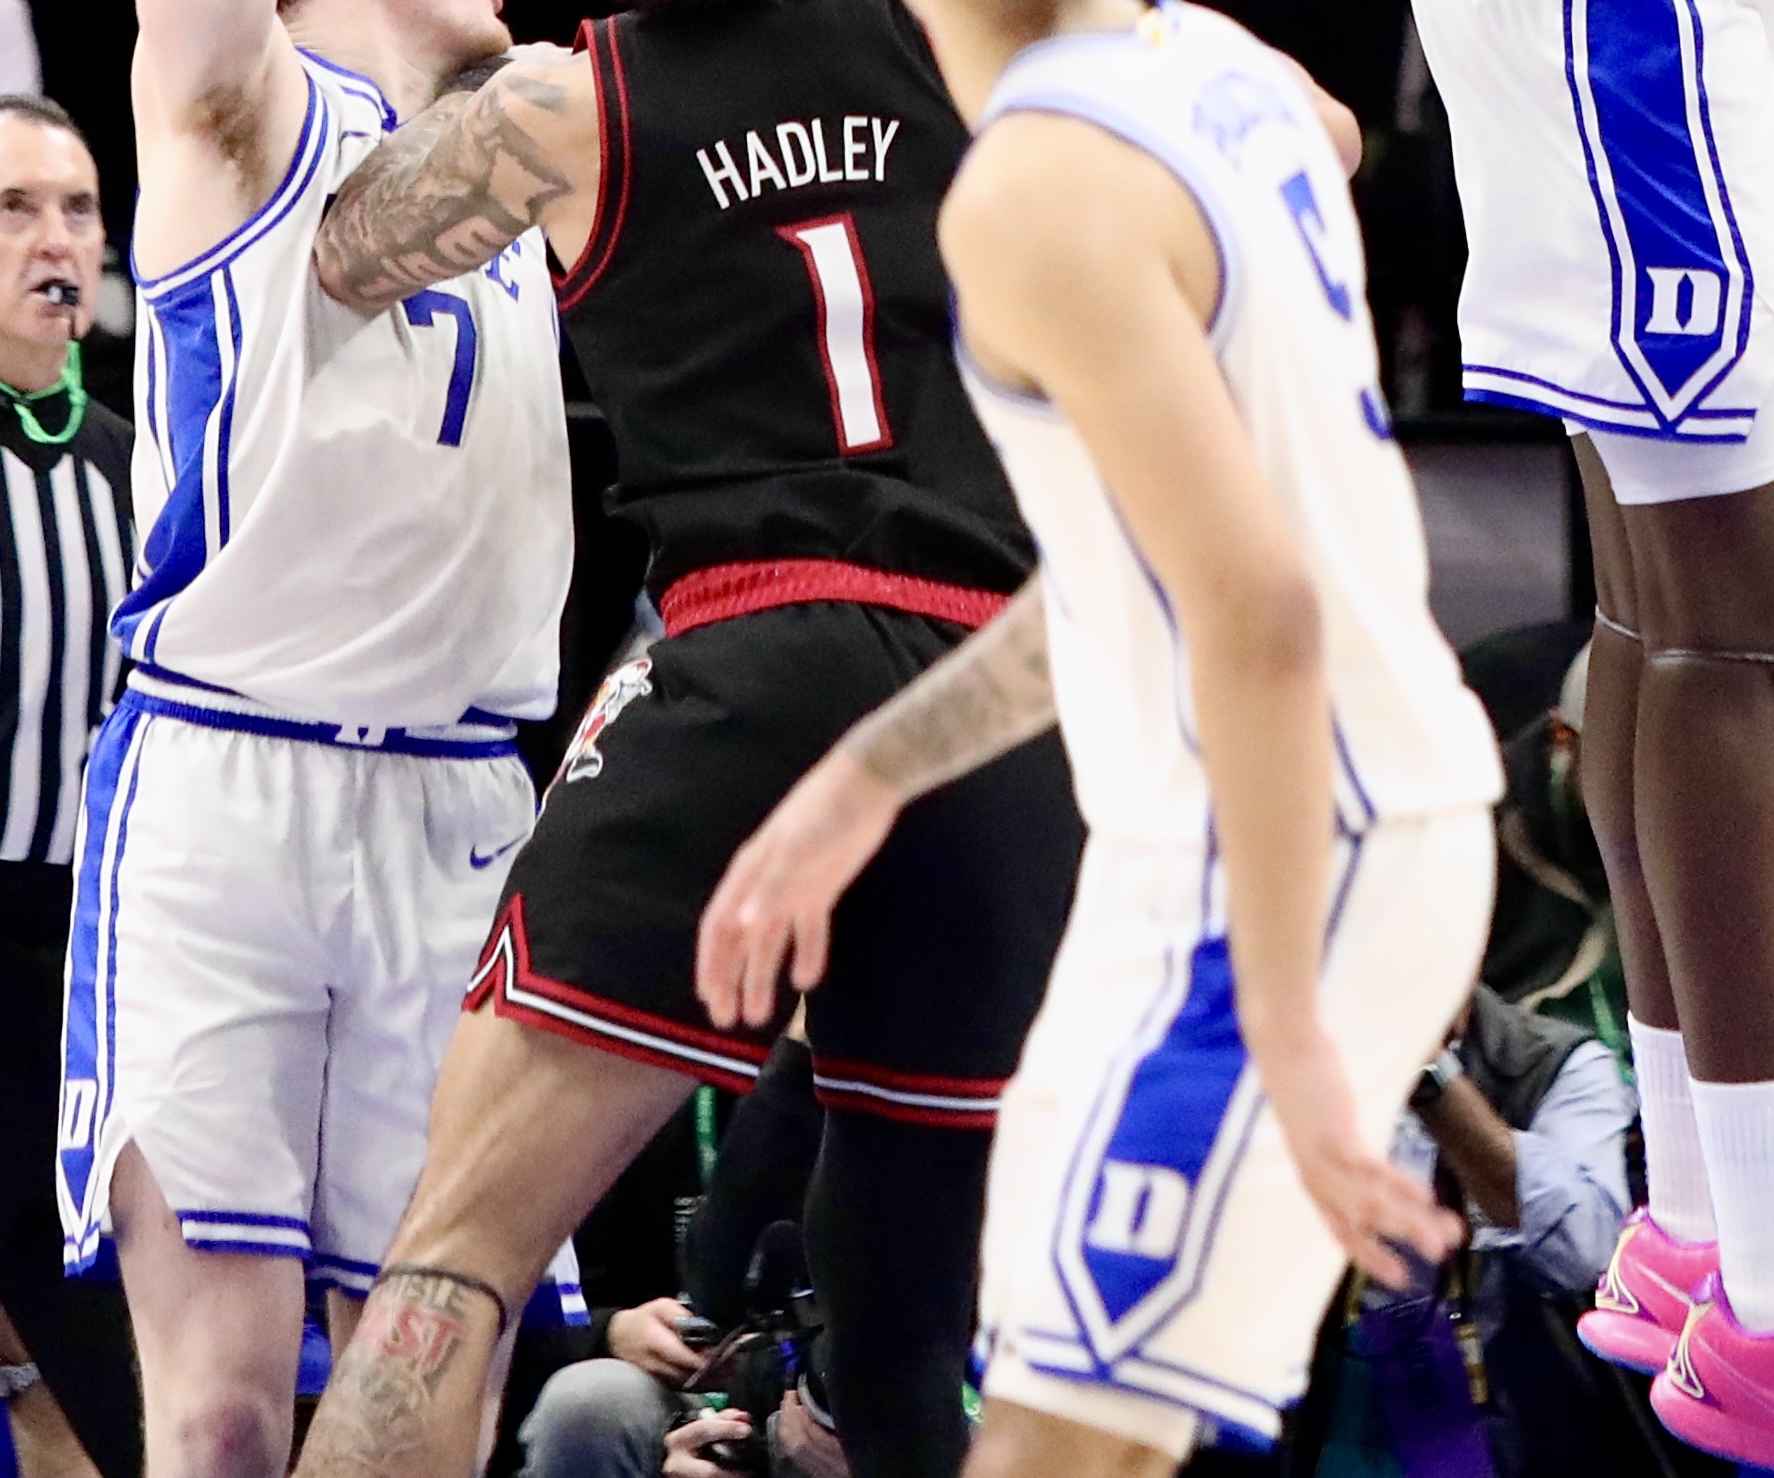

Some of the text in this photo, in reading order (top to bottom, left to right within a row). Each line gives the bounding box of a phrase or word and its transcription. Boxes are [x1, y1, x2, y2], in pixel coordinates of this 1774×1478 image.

[696, 115, 899, 210] HADLEY
[402, 288, 477, 448] 7
[773, 212, 894, 457] 1
